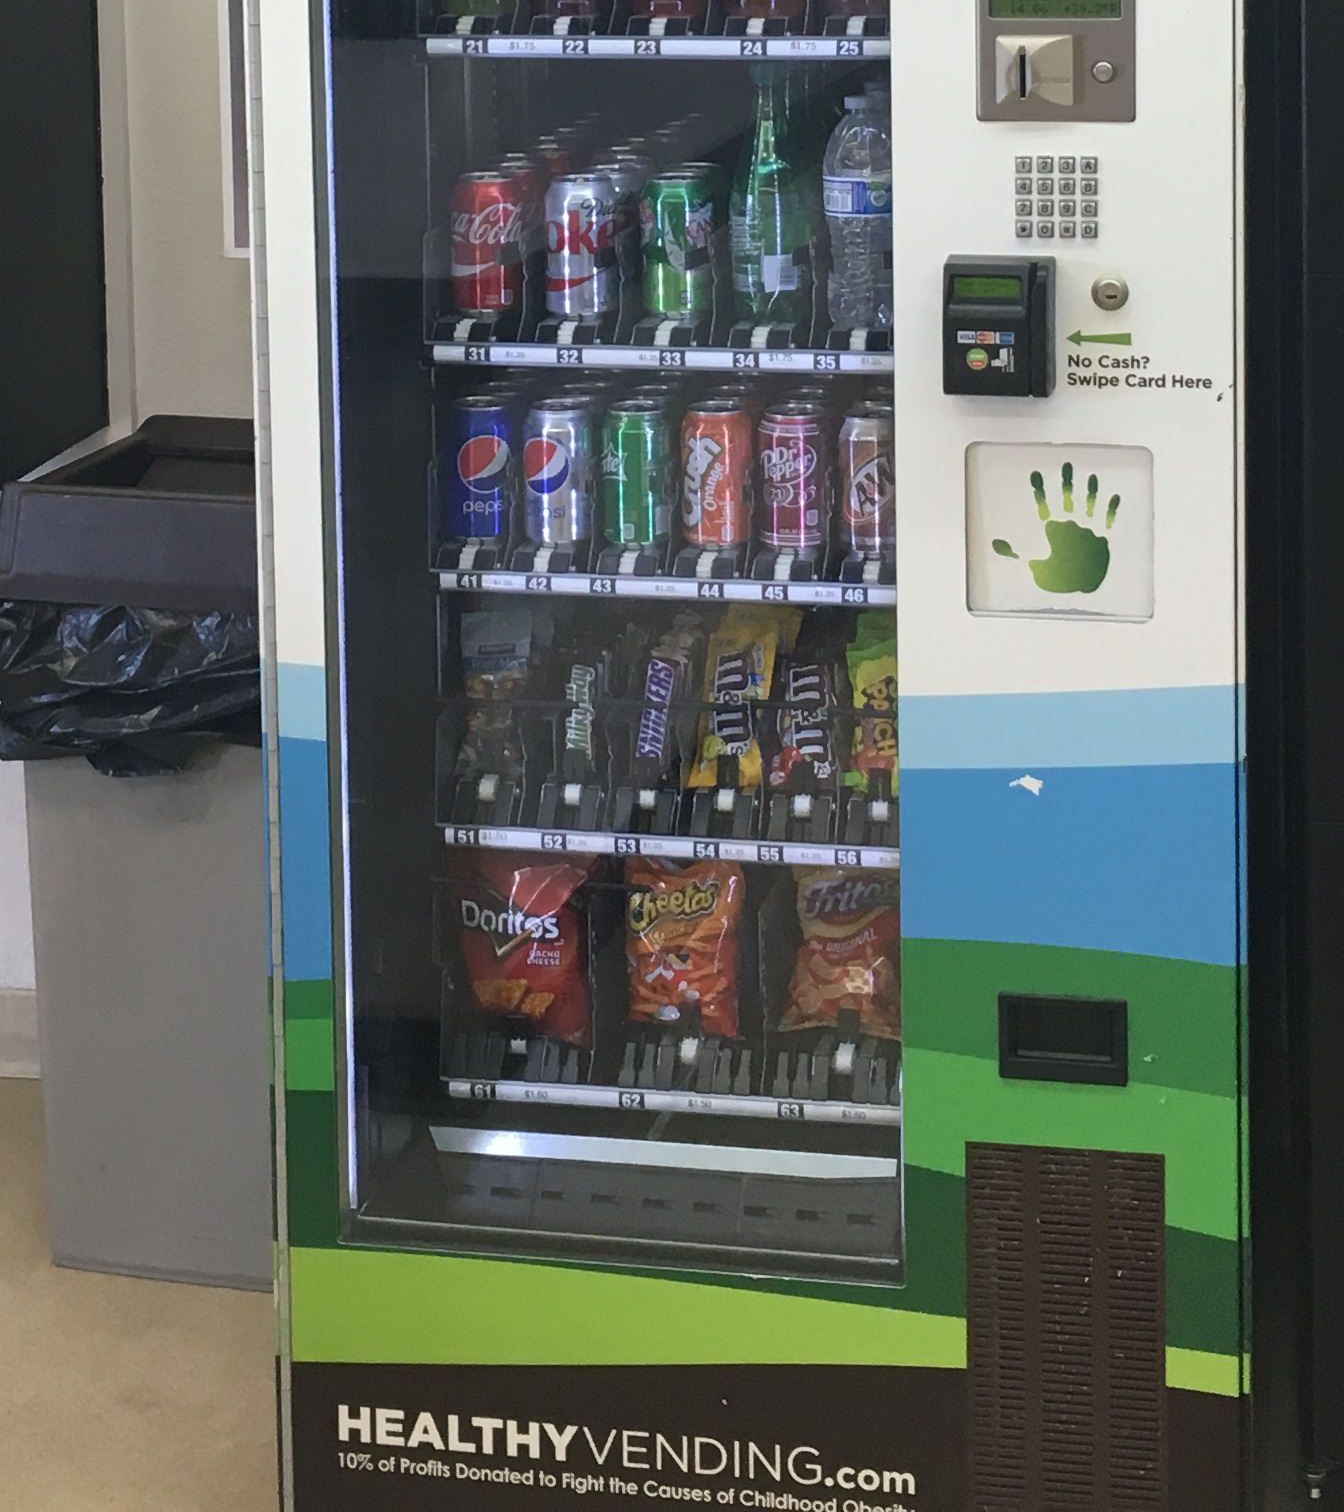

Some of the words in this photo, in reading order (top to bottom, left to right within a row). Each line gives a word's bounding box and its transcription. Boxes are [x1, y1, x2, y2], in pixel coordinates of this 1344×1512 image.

[564, 39, 584, 55] 22
[742, 39, 763, 55] 24
[838, 39, 859, 55] 25
[661, 350, 682, 366] 33
[734, 352, 755, 368] 34
[1067, 354, 1092, 369] No
[1098, 354, 1150, 369] Cash?
[1066, 372, 1120, 389] Swipe
[1124, 374, 1166, 388] Card
[1171, 374, 1213, 389] Here
[775, 447, 797, 462] Dr
[760, 450, 812, 481] Pepper
[703, 462, 724, 511] Orange
[528, 575, 548, 591] 42
[701, 582, 721, 599] 44
[616, 839, 637, 853] 53
[695, 843, 716, 858] 54
[629, 883, 716, 931] Cheetos
[460, 899, 559, 940] Doritos
[621, 1092, 641, 1108] 62
[780, 1103, 801, 1118] 63
[337, 1404, 916, 1495] HEALTHYVENDING.com
[337, 1451, 374, 1471] 10%
[378, 1455, 396, 1473] of
[400, 1457, 451, 1478] Profits
[456, 1463, 534, 1486] Donated
[538, 1471, 557, 1488] to
[562, 1472, 605, 1494] Fight
[609, 1477, 638, 1495] the
[643, 1480, 712, 1503] Causes
[717, 1488, 735, 1505] of
[739, 1490, 837, 1512] Childhood
